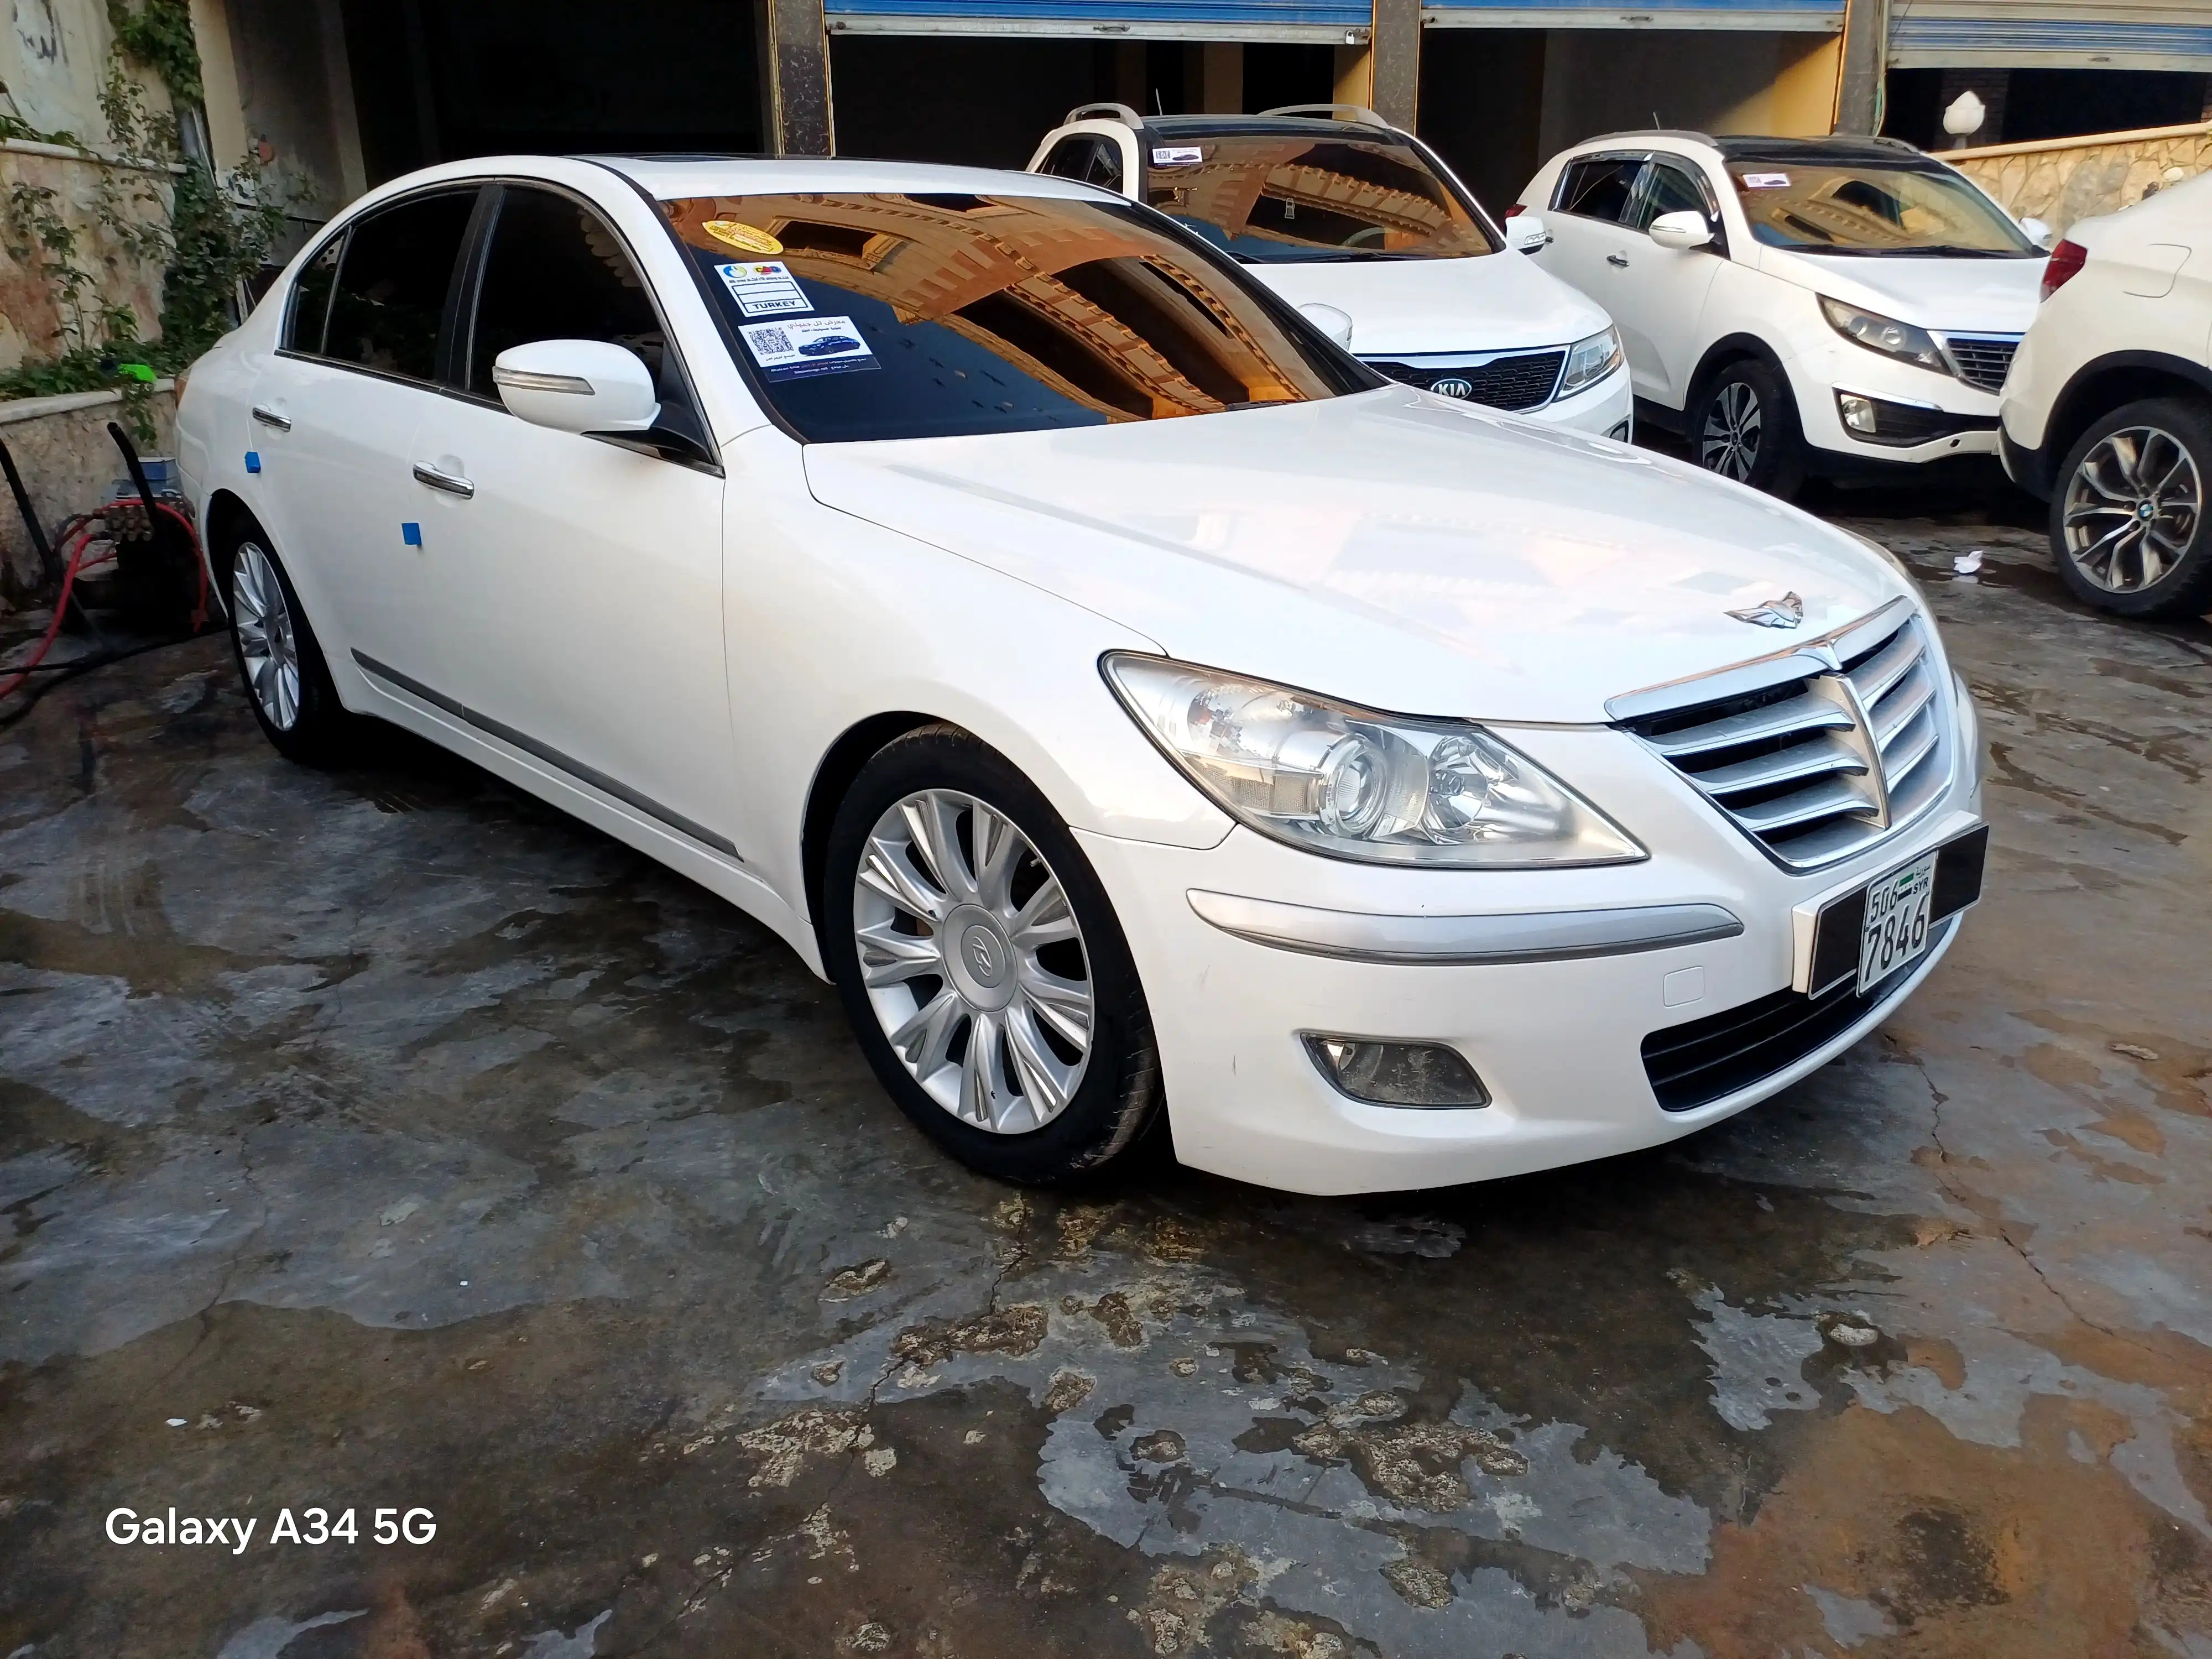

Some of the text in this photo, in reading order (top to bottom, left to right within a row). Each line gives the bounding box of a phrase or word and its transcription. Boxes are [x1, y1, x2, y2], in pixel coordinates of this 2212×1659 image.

[752, 301, 795, 310] TURKEY
[1438, 383, 1466, 397] KIA
[1913, 877, 1929, 895] SYR
[1869, 879, 1899, 923] 506
[1864, 891, 1929, 982] 7846
